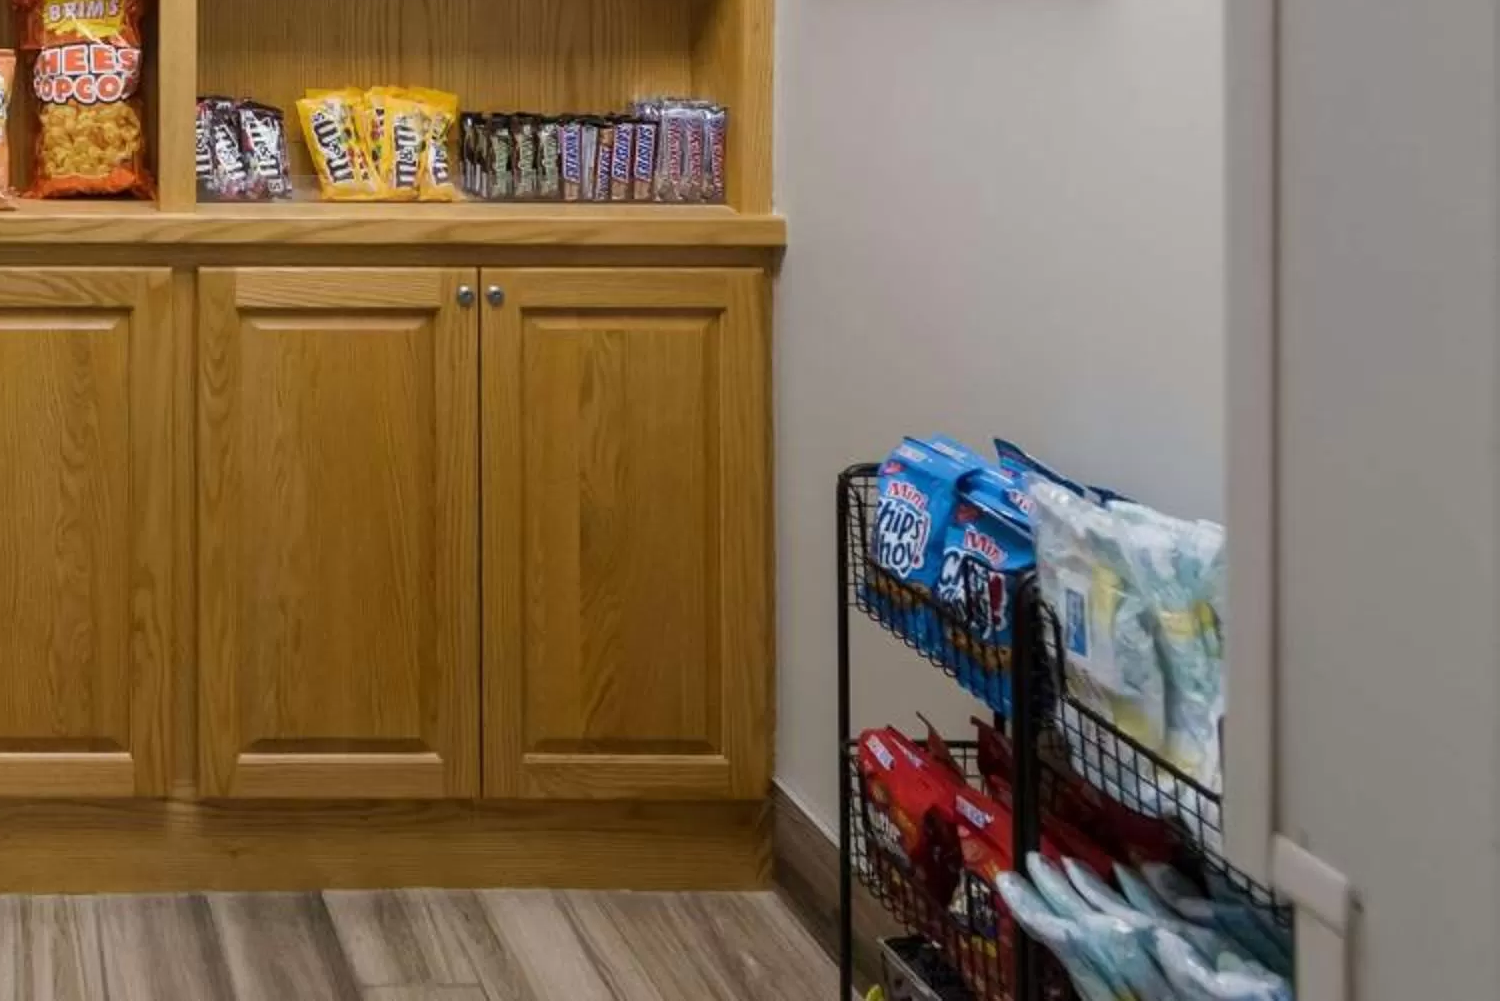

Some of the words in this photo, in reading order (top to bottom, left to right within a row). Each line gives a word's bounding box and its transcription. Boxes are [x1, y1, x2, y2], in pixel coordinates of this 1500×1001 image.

[35, 44, 141, 76] HEES
[34, 74, 137, 104] OPCO
[878, 499, 921, 540] hips
[879, 515, 931, 577] hoy!
